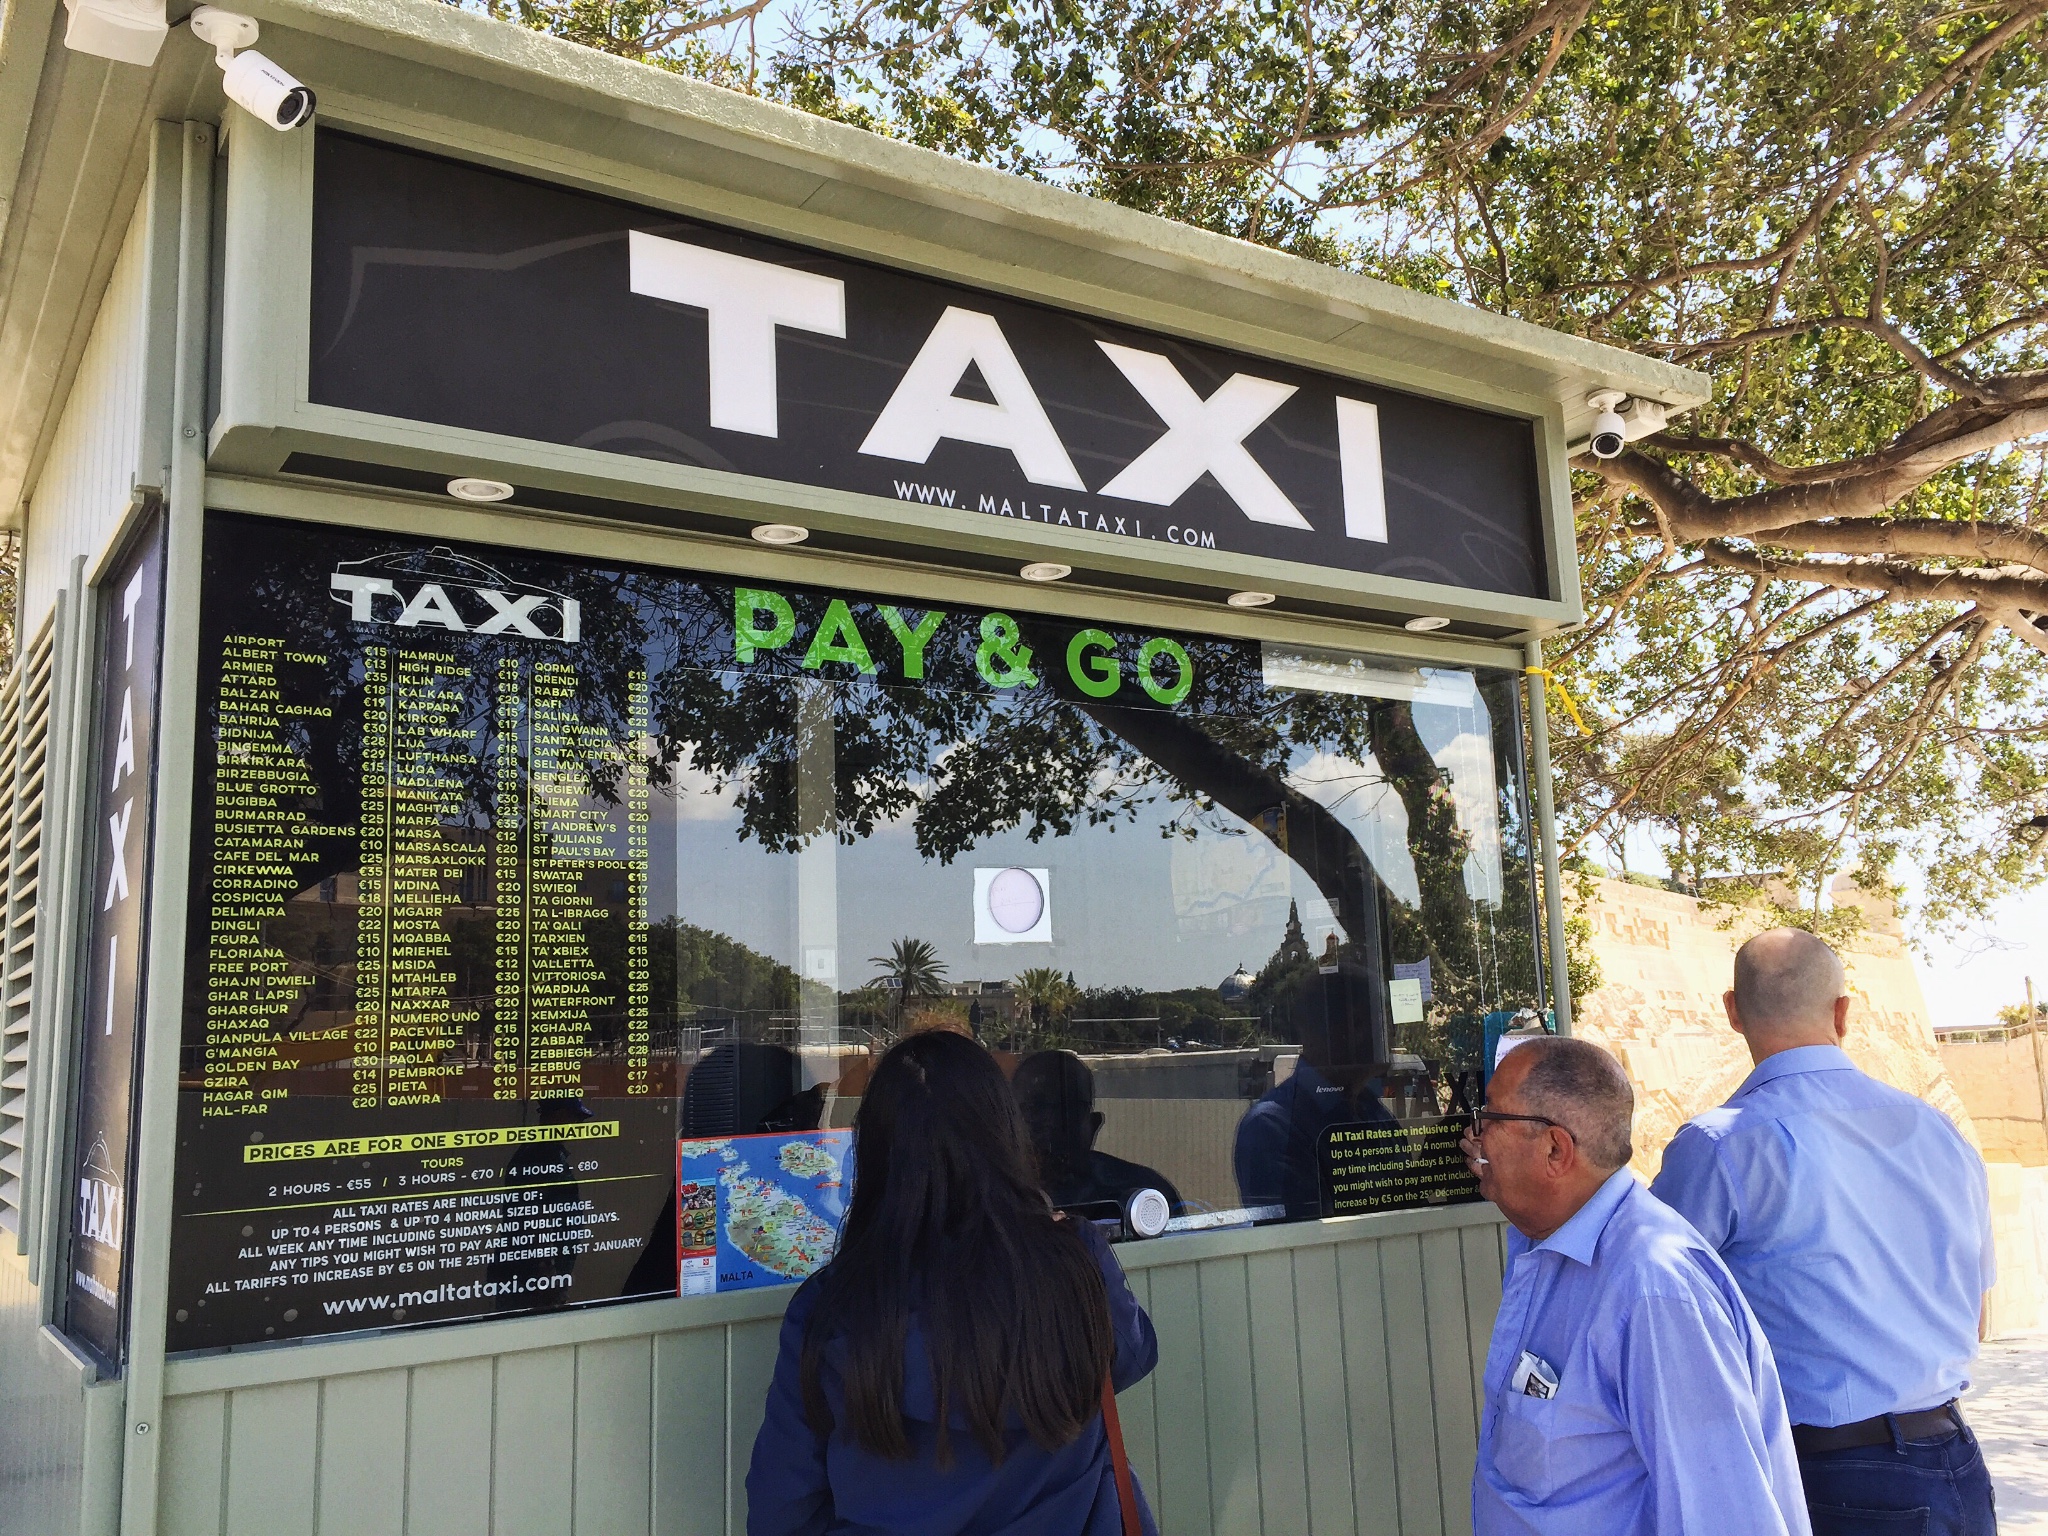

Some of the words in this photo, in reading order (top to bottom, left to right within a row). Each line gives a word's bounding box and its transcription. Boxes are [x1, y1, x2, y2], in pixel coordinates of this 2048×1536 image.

[629, 229, 1388, 544] TAXI
[330, 573, 581, 643] TAXI
[223, 634, 285, 648] AIRPORT
[364, 646, 387, 656] €15
[735, 587, 947, 679] PAY
[975, 612, 1039, 689] &
[1066, 628, 1193, 705] GO
[222, 648, 278, 660] ALBERT
[284, 652, 327, 664] TOWN
[364, 659, 387, 669] €13
[222, 661, 274, 673] ARMIER
[364, 672, 388, 682] €35
[221, 674, 277, 686] ATTARD
[364, 685, 386, 695] €18
[220, 687, 280, 700] BALZAN
[363, 698, 386, 707] €19
[534, 687, 575, 697] RABAT
[628, 695, 648, 703] €20
[219, 701, 269, 712] BAHAR
[275, 705, 332, 717] CAGHAQ
[363, 710, 387, 720] €20
[534, 711, 579, 722] SALINA
[628, 718, 648, 727] €23
[217, 769, 310, 781] BIRZEBBUGIA
[362, 775, 385, 785] €20
[104, 563, 143, 1036] TAXI
[215, 796, 277, 807] BUGIBBA
[361, 801, 384, 811] €25
[215, 810, 306, 821] BURMARRAD
[360, 814, 384, 824] €25
[214, 838, 304, 848] CATAMARAN
[360, 841, 383, 850] €10
[213, 865, 293, 875] CIRKEWWA
[359, 867, 383, 876] €35
[394, 882, 440, 890] MDINA
[497, 883, 521, 891] €20
[533, 884, 577, 893] SWIEQI
[628, 885, 648, 894] €17
[394, 894, 462, 903] MELLIEHA
[497, 895, 521, 904] €30
[211, 907, 286, 917] DELIMARA
[358, 907, 382, 917] €20
[393, 921, 440, 930] MOSTA
[496, 921, 520, 930] €20
[210, 935, 259, 944] FGURA
[357, 934, 380, 943] €15
[532, 934, 585, 943] TARXIEN
[628, 934, 648, 943] €15
[209, 963, 244, 973] FREE
[250, 963, 289, 972] PORT
[357, 961, 381, 970] €25
[532, 959, 594, 968] VALLETTA
[628, 959, 648, 967] €10
[392, 987, 447, 996] MTARFA
[495, 986, 519, 994] €20
[531, 996, 615, 1007] WATERFRONT
[628, 996, 648, 1004] €10
[390, 1026, 463, 1037] PACEVILLE
[494, 1024, 517, 1033] €15
[205, 1061, 266, 1073] GOLDEN
[273, 1059, 300, 1069] BAY
[353, 1056, 378, 1066] €30
[204, 1077, 249, 1087] GZIRA
[353, 1070, 376, 1080] €14
[389, 1082, 427, 1092] PIETA
[494, 1077, 517, 1086] €10
[530, 1089, 584, 1099] ZURRIEQ
[627, 1085, 648, 1094] €20
[1316, 1085, 1344, 1093] lenovo
[203, 1104, 268, 1117] HAL-FAR
[352, 1098, 377, 1108] €20
[1330, 1132, 1343, 1142] All
[1344, 1131, 1364, 1141] Taxi
[1366, 1128, 1392, 1140] Rates
[1394, 1129, 1408, 1137] are
[1410, 1125, 1449, 1136] inclusive
[1450, 1122, 1462, 1132] of:
[250, 1145, 315, 1160] PRICES
[324, 1141, 360, 1155] ARE
[368, 1138, 403, 1152] FOR
[411, 1135, 446, 1149] ONE
[454, 1132, 499, 1146] STOP
[507, 1124, 613, 1142] DESTINATION
[1331, 1149, 1342, 1160] Up
[1344, 1150, 1353, 1158] to
[1355, 1148, 1361, 1156] 4
[1362, 1145, 1393, 1158] persons
[1395, 1144, 1400, 1152] &
[1402, 1144, 1412, 1154] up
[1423, 1141, 1429, 1149] 4
[1431, 1139, 1457, 1149] normal
[421, 1157, 464, 1169] TOURS
[1333, 1183, 1348, 1194] you
[1350, 1178, 1374, 1190] might
[1375, 1178, 1392, 1188] wish
[1395, 1177, 1403, 1185] to
[1405, 1176, 1418, 1186] pay
[1434, 1172, 1447, 1181] not
[1448, 1171, 1474, 1181] include
[333, 1205, 356, 1219] ALL
[360, 1205, 386, 1216] TAXI
[392, 1199, 429, 1214] RATES
[433, 1199, 456, 1210] ARE
[461, 1193, 519, 1207] INCLUSIVE
[523, 1191, 543, 1201] OF:
[80, 1177, 124, 1251] TAXI
[271, 1229, 289, 1240] UP
[293, 1227, 309, 1238] TO
[312, 1226, 320, 1236] 4
[325, 1220, 381, 1235] PERSONS
[390, 1219, 399, 1229] &
[404, 1217, 420, 1227] UP
[424, 1214, 439, 1225] TO
[444, 1214, 451, 1224] 4
[456, 1208, 503, 1222] NORMAL
[507, 1205, 539, 1217] SIZED
[542, 1200, 594, 1214] LUGGAGE.
[238, 1247, 262, 1259] ALL
[267, 1243, 304, 1257] WEEK
[308, 1240, 334, 1252] ANY
[338, 1237, 367, 1249] TIME
[373, 1231, 435, 1246] INCLUDING
[439, 1224, 492, 1239] SUNDAYS
[496, 1222, 519, 1233] AND
[523, 1217, 562, 1230] PUBLIC
[566, 1212, 620, 1226] HOLIDAYS.
[205, 1282, 230, 1294] ALL
[235, 1276, 287, 1290] TARIFFS
[291, 1273, 308, 1285] TO
[313, 1267, 374, 1283] INCREASE
[378, 1264, 394, 1276] BY
[398, 1263, 413, 1274] €5
[417, 1259, 435, 1271] ON
[439, 1257, 462, 1269] THE
[466, 1254, 495, 1266] 25TH
[499, 1247, 558, 1262] DECEMBER
[562, 1244, 570, 1255] &
[572, 1242, 589, 1254] 1ST
[593, 1238, 643, 1252] JANUARY.
[720, 1271, 754, 1283] MALTA
[323, 1273, 572, 1316] www.maltataxi.com
